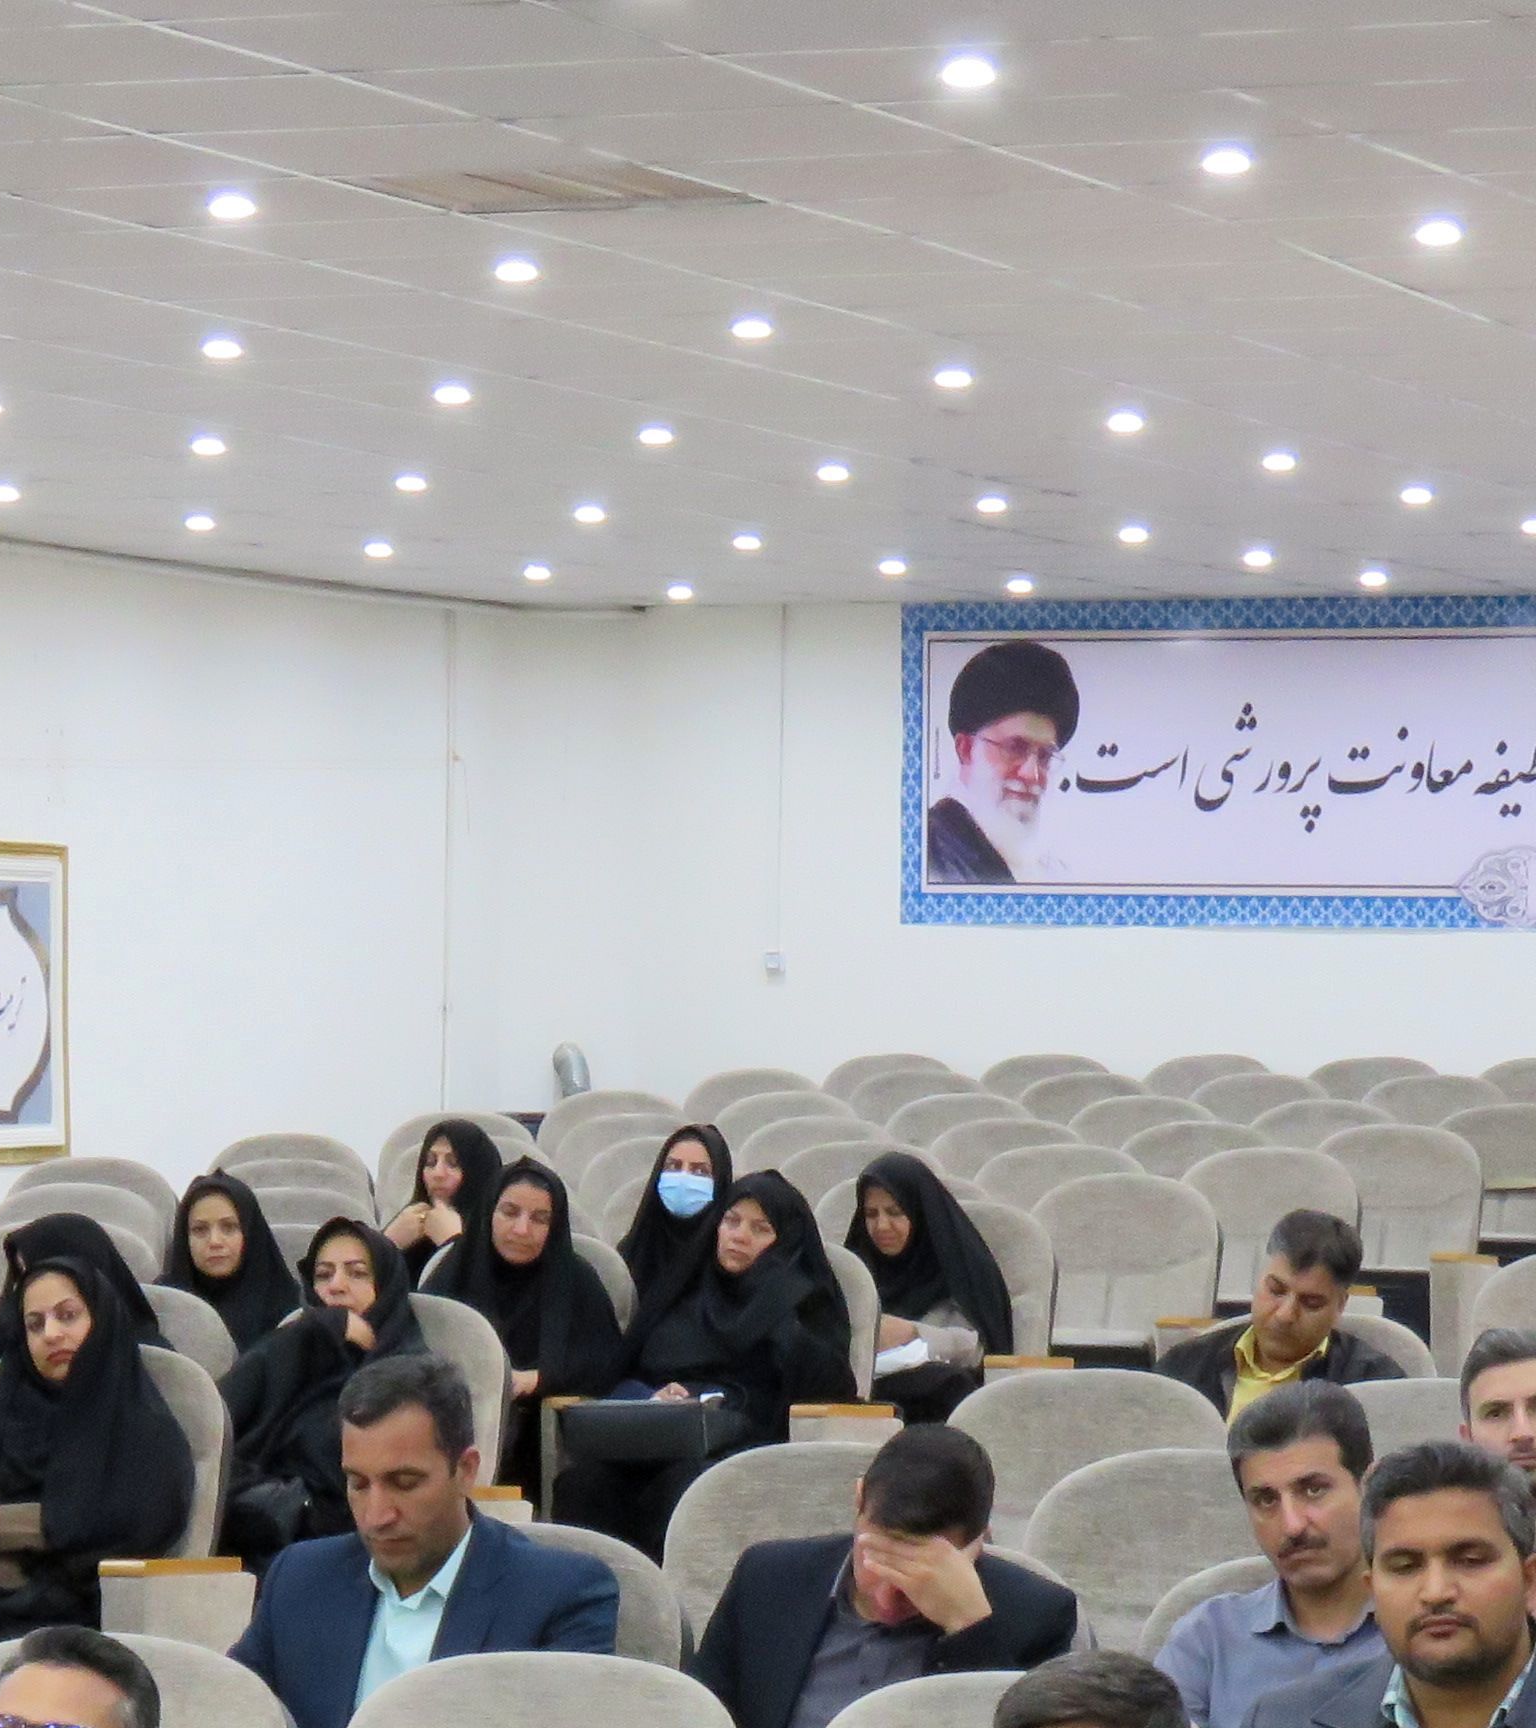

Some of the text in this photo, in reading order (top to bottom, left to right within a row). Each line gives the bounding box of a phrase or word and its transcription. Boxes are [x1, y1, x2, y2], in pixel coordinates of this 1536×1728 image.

[1058, 743, 1188, 794] است.
[1193, 702, 1322, 834] پرورشی
[1327, 726, 1474, 795] معاونت
